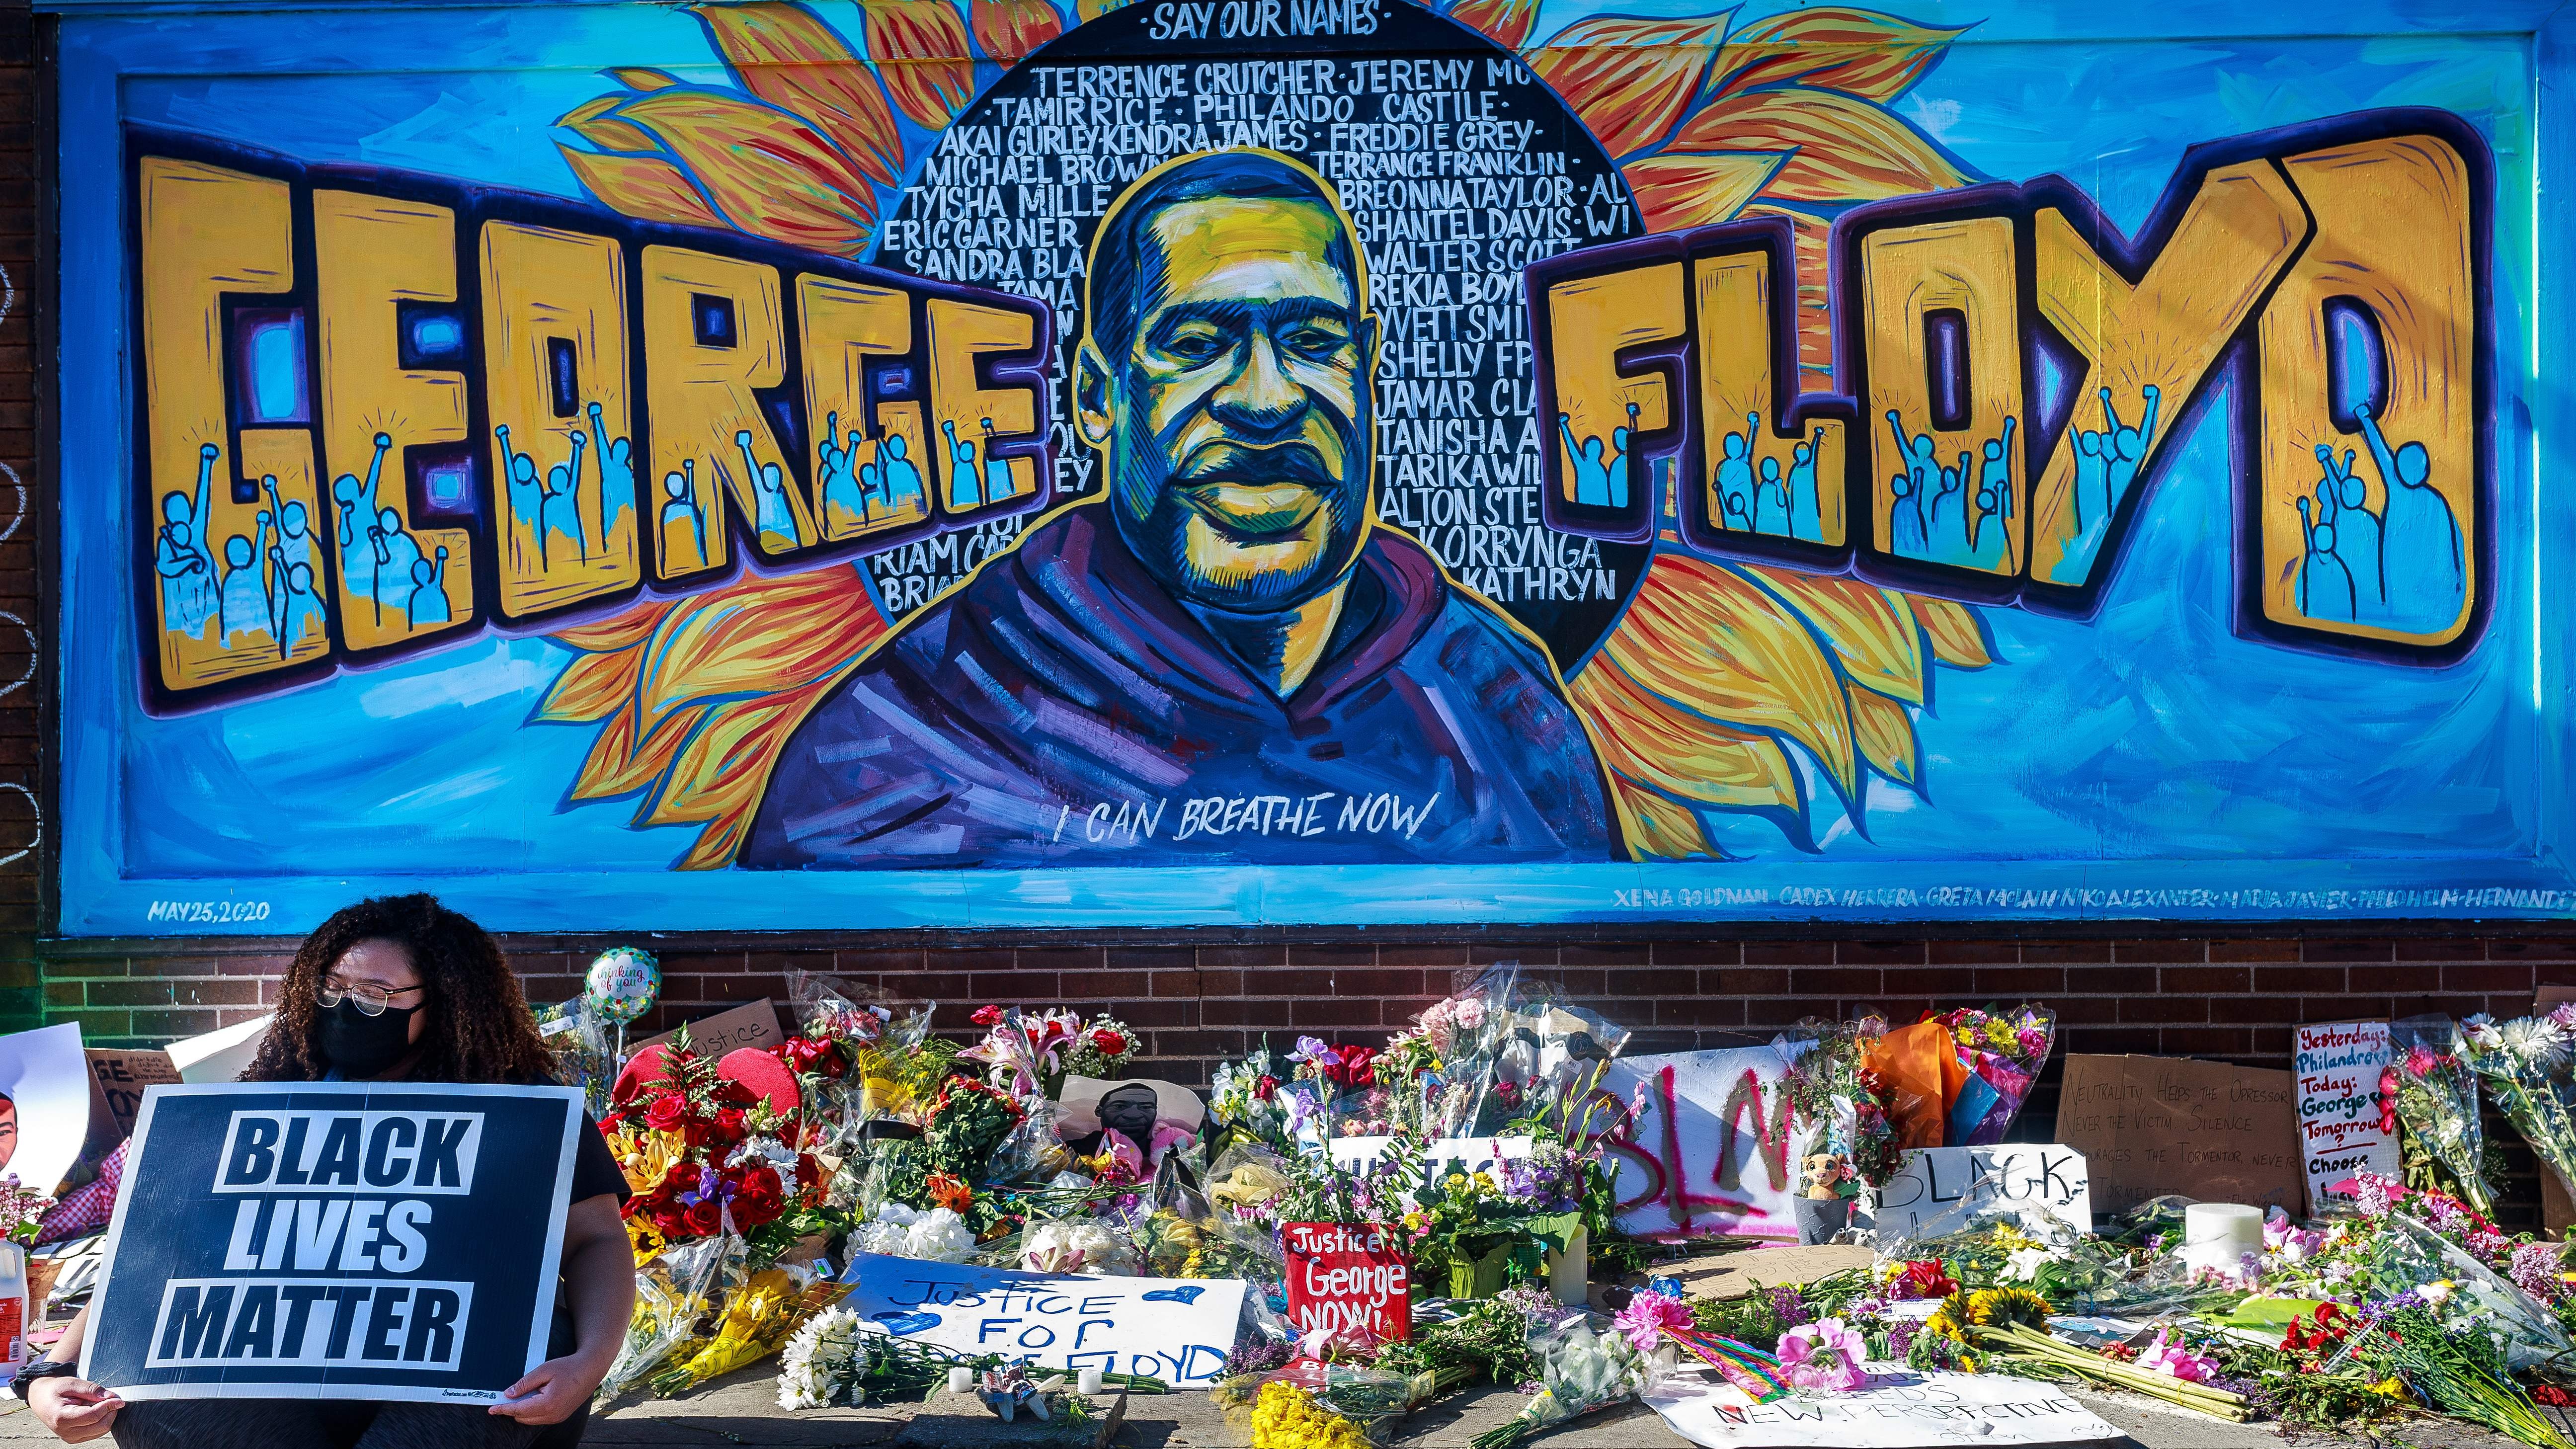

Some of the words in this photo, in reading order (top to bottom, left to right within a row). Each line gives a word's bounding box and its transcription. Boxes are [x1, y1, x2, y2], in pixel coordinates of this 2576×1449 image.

[1150, 1, 1217, 39] SAY
[1221, 1, 1281, 38] OUR
[1291, 0, 1379, 35] NAMES
[1030, 65, 1188, 98] TERRENCE
[1195, 60, 1338, 97] CRUTCHER
[1348, 59, 1474, 95] JEREMY
[1194, 94, 1355, 122] PHILANDO
[1383, 91, 1499, 122] CASTILE
[938, 126, 1000, 157] AKAI
[1008, 126, 1100, 157] GURLEY
[1103, 124, 1210, 155] KENDRA
[1213, 121, 1308, 152] JAMES
[1331, 122, 1449, 152] FREDDIE
[1456, 119, 1534, 151] GREY
[926, 156, 1053, 186] MICHAEL
[1310, 151, 1433, 179] TERRANCE
[1439, 150, 1565, 175] FRANKLIN
[904, 186, 1005, 222] TYISHA
[1019, 185, 1111, 217] MILLE
[1589, 173, 1627, 204] AL
[885, 219, 949, 250] ERIC
[954, 218, 1084, 249] GARNER
[1355, 209, 1485, 242] SHANTEL
[1487, 206, 1572, 239] DAVIS
[1584, 205, 1629, 236] WI
[905, 248, 1025, 281] SANDRA
[1033, 248, 1087, 279] BLA
[1362, 240, 1485, 274] WALTER
[1487, 238, 1582, 273] SCOTT
[1369, 273, 1456, 307] REKIA
[1372, 305, 1464, 342] YVETT
[1466, 304, 1522, 342] SMI
[1378, 341, 1485, 379] SHELLY
[134, 149, 1041, 691] GEORGE
[1543, 127, 2480, 648] FLOYD
[1374, 379, 1483, 420] JAMAR
[1376, 418, 1510, 454] TANISHA
[1377, 454, 1491, 487] TARIKA
[1379, 486, 1478, 527] ALTON
[1483, 486, 1539, 526] STE
[1419, 525, 1603, 569] KORRYNGA
[1463, 566, 1616, 602] KATHRYN
[1052, 804, 1070, 843] I
[1085, 797, 1167, 845] CAN
[1172, 791, 1338, 842] BREATHE
[1337, 791, 1442, 841] NOW
[1611, 888, 1674, 908] XENA
[1779, 886, 1838, 907] CADEX
[1840, 888, 1919, 908] HERRERA
[1926, 886, 1983, 908] GRETA
[600, 976, 612, 991] of
[616, 976, 637, 993] you
[2297, 1046, 2373, 1074] Philandro
[2199, 1085, 2218, 1101] THE
[2300, 1074, 2357, 1098] Today:
[2106, 1114, 2127, 1131] THE
[2301, 1094, 2367, 1120] George
[2302, 1117, 2383, 1141] Tomorrow
[224, 1116, 473, 1188] BLACK
[2144, 1148, 2167, 1163] THE
[2252, 1152, 2297, 1169] NEVER
[1875, 1151, 2073, 1209] BLACK
[224, 1199, 433, 1273] LIVES
[1292, 1225, 1380, 1254] Justice
[1306, 1256, 1406, 1308] George
[156, 1286, 461, 1364] MATTER
[1712, 1404, 1823, 1425] NEW
[1840, 1397, 2085, 1422] PERSPECTIVE
